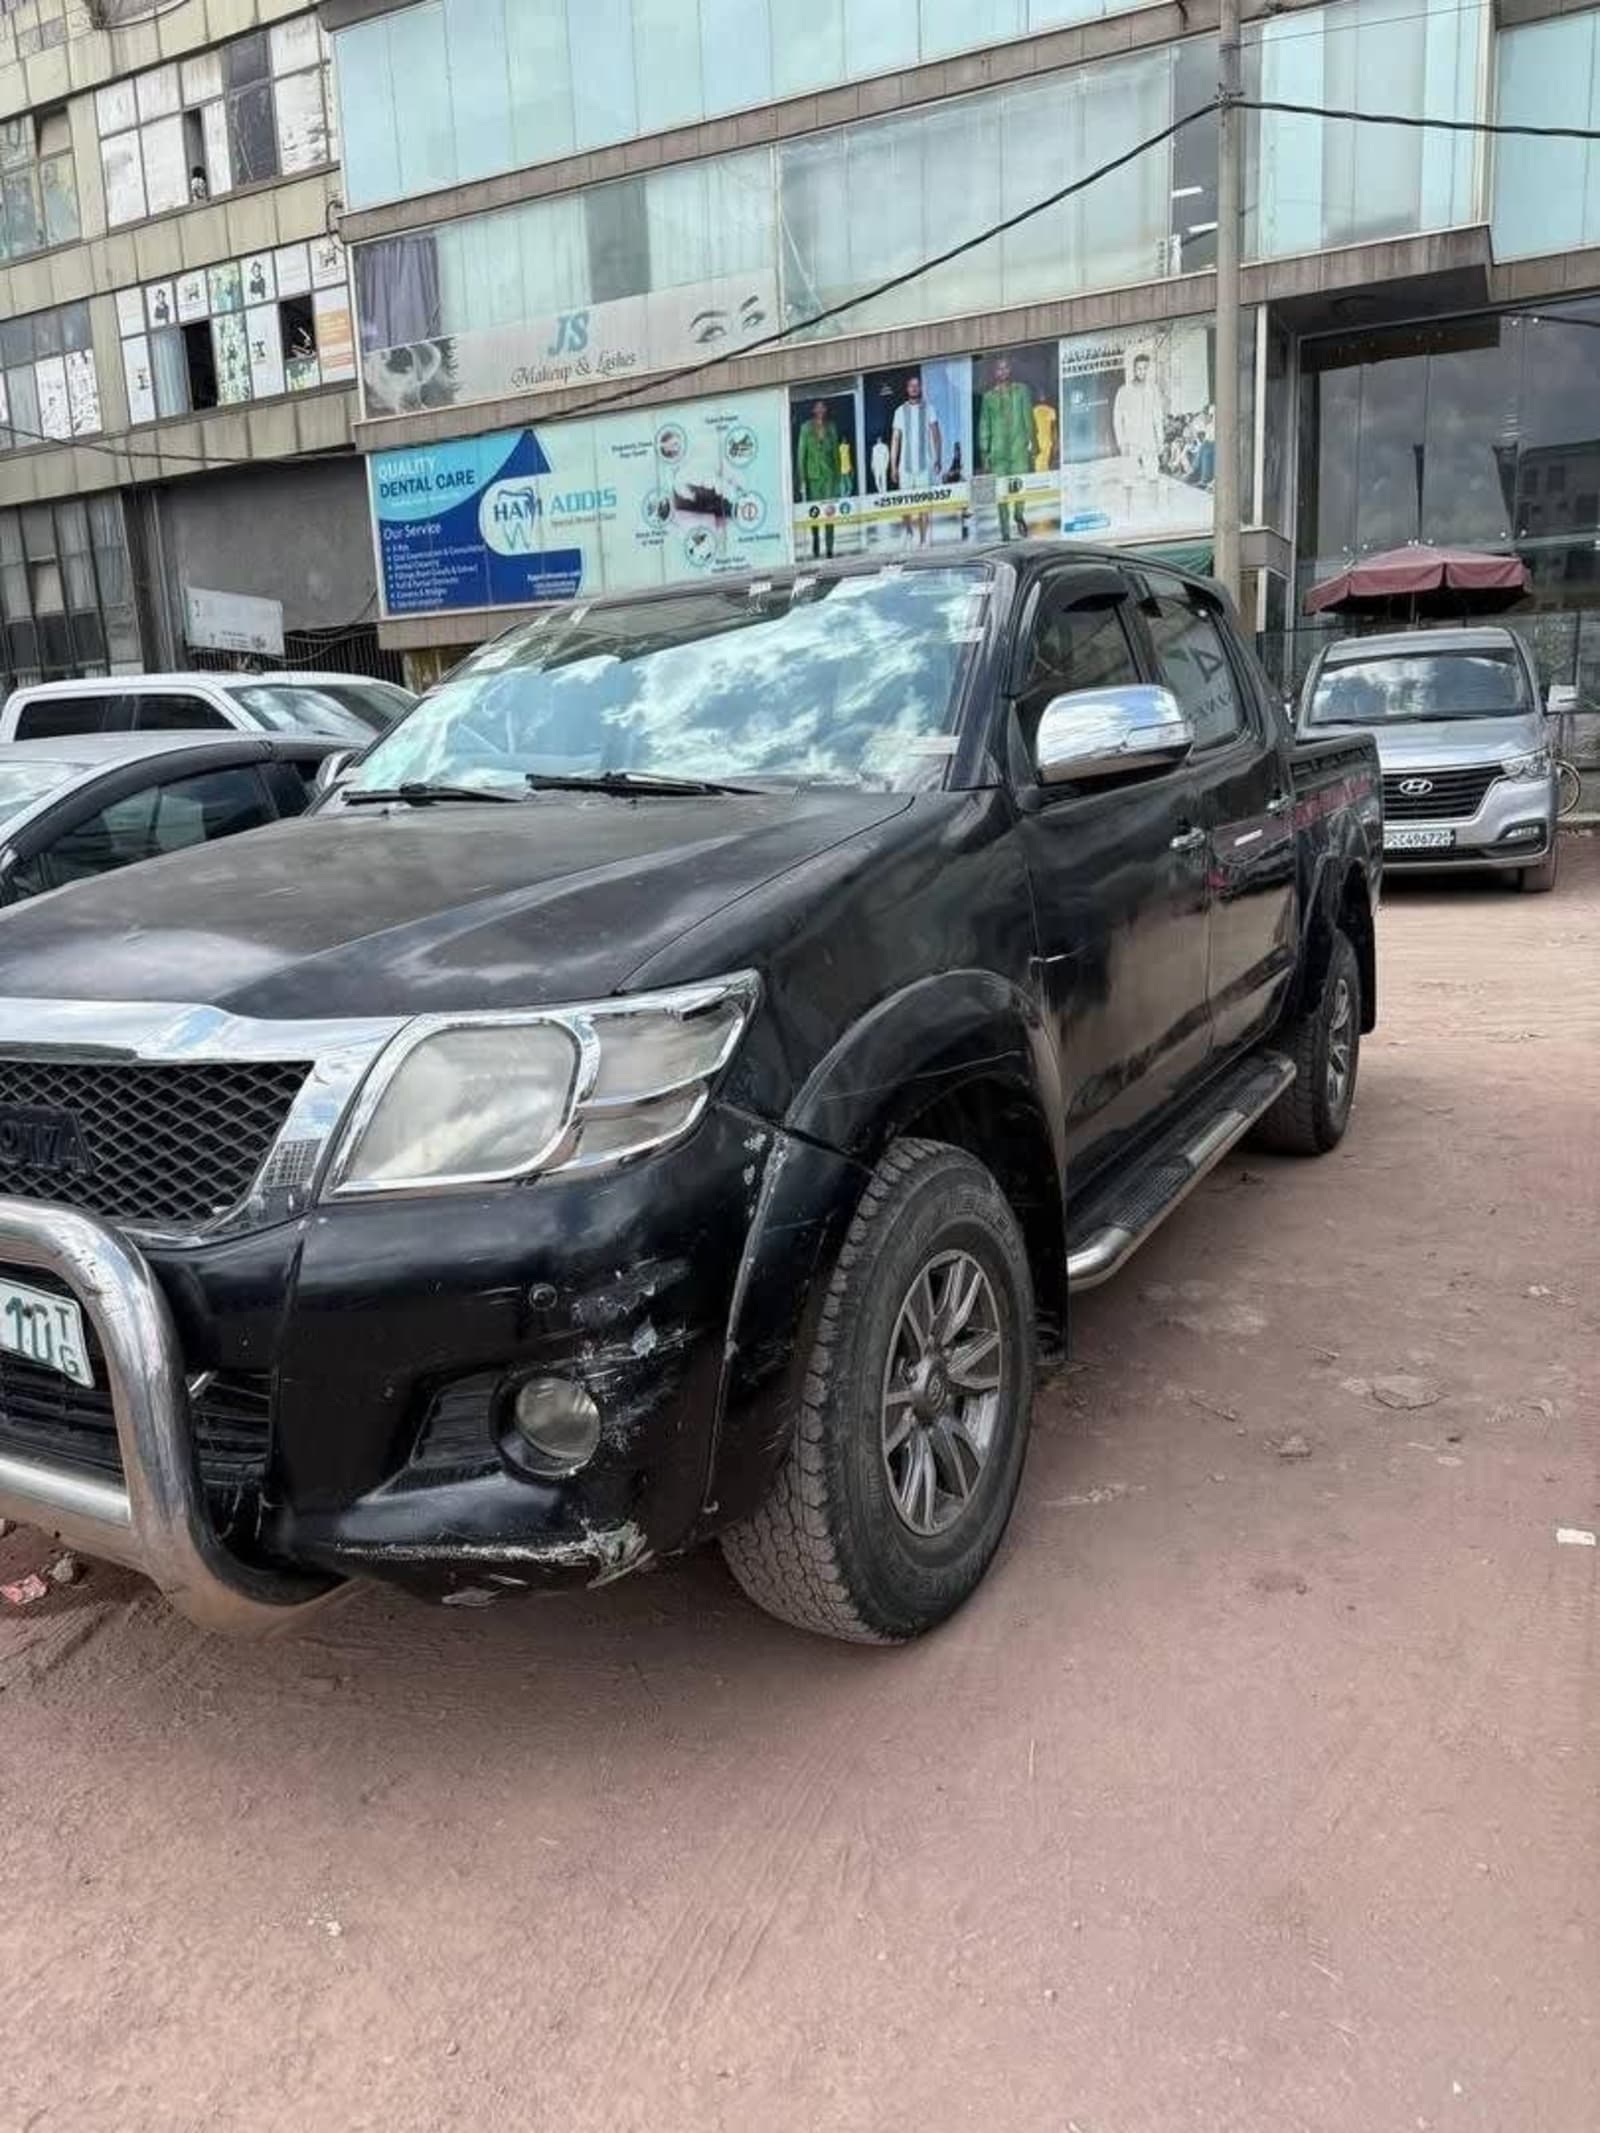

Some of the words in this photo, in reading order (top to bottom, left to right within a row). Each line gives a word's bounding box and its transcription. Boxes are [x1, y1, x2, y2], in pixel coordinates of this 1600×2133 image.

[548, 311, 590, 356] JS
[575, 355, 592, 377] &
[378, 455, 437, 481] QUALITY
[379, 476, 433, 499] DENTAL
[436, 470, 475, 488] CARE
[493, 497, 543, 523] HAM
[550, 487, 617, 515] ADDIS
[383, 528, 402, 541] Our
[404, 523, 441, 537] Service
